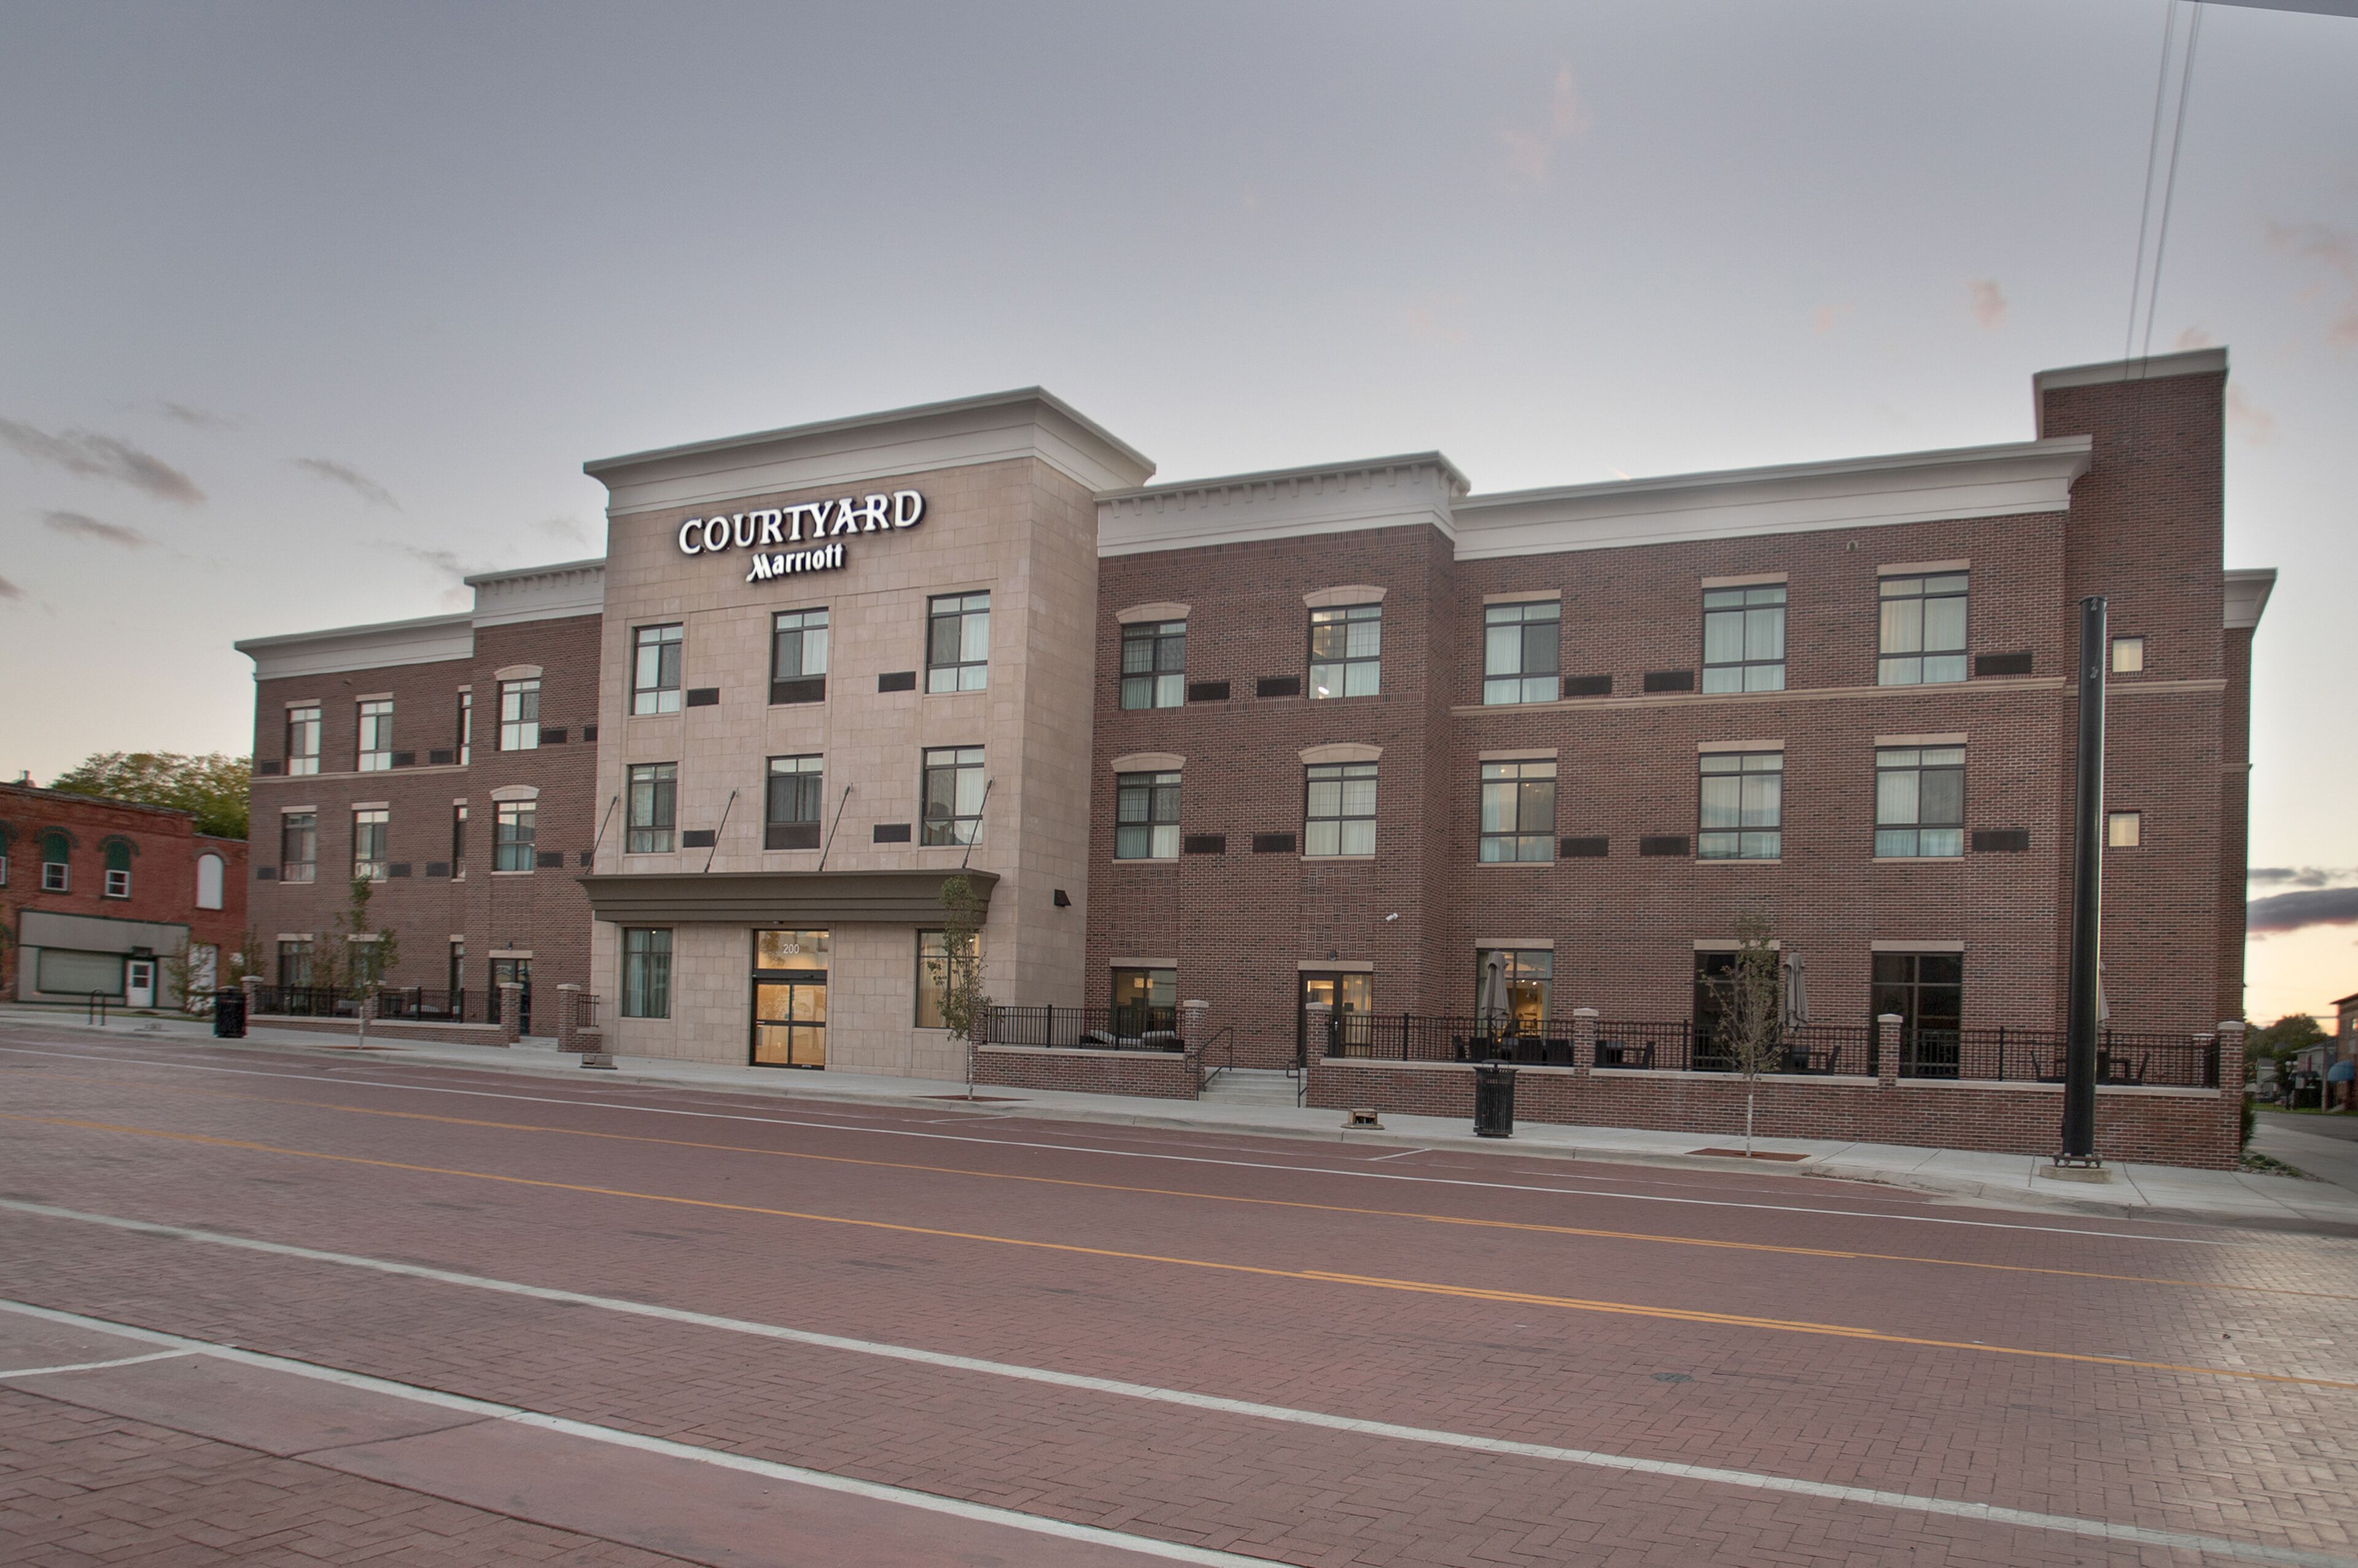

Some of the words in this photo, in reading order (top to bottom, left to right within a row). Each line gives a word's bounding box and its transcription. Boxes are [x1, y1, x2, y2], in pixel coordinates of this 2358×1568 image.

[678, 490, 924, 554] COURTYARD
[745, 543, 846, 583] Marriott
[783, 944, 800, 953] 200
